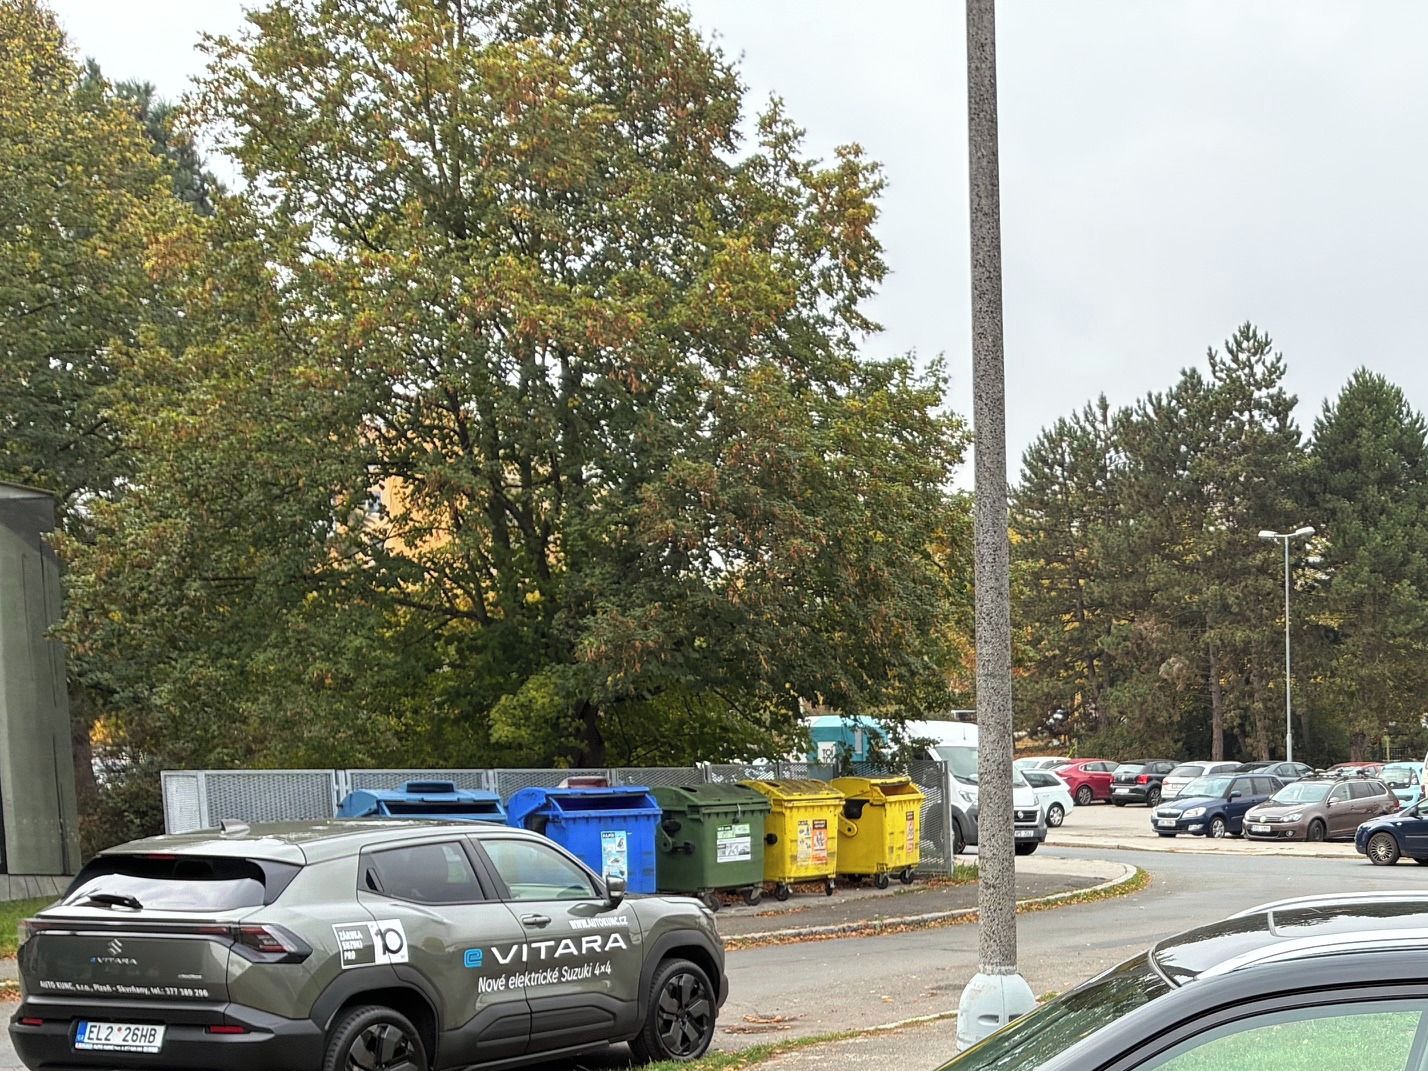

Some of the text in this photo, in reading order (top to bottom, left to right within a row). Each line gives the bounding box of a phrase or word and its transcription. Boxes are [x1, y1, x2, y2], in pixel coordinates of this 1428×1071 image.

[491, 933, 627, 964] VITARA
[40, 980, 55, 989] AUTO
[478, 974, 506, 993] Nové
[508, 966, 559, 989] elektrické
[561, 962, 592, 981] Suzuki
[87, 1024, 157, 1044] EL2 26HB
